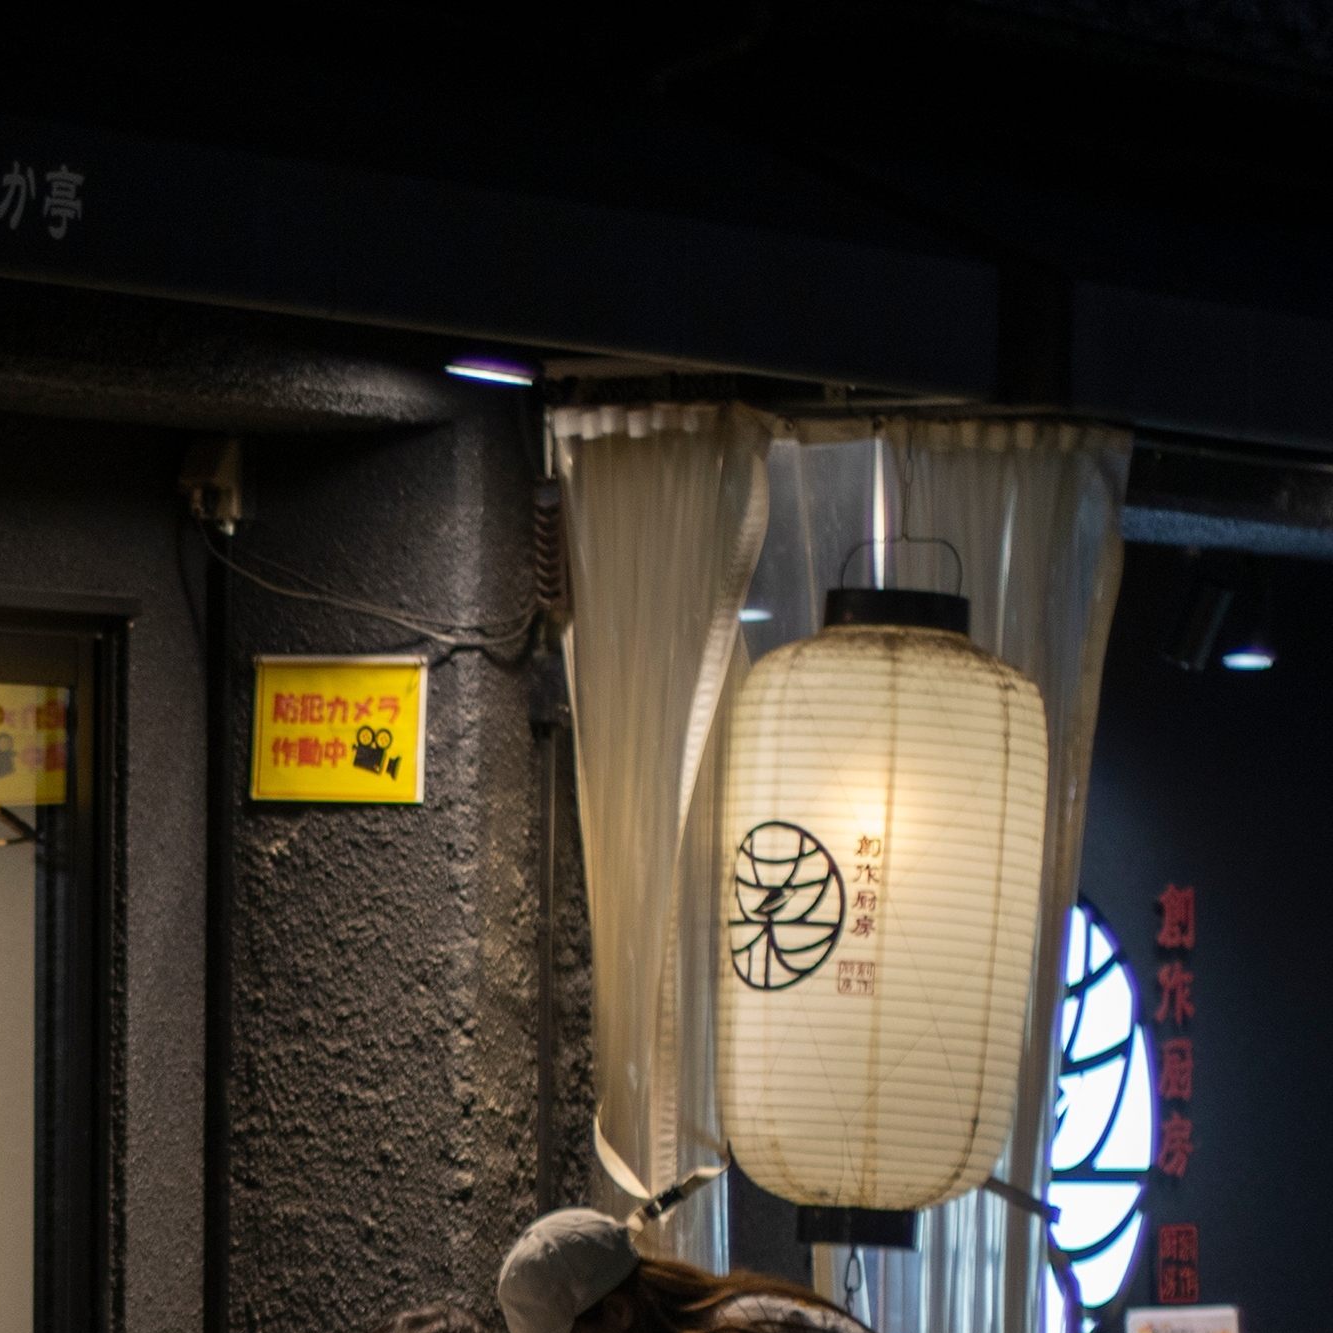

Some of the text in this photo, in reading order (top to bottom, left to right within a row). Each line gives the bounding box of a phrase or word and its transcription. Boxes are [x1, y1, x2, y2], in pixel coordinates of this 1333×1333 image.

[271, 692, 400, 725] 防犯カメラ
[271, 736, 348, 769] 作動中
